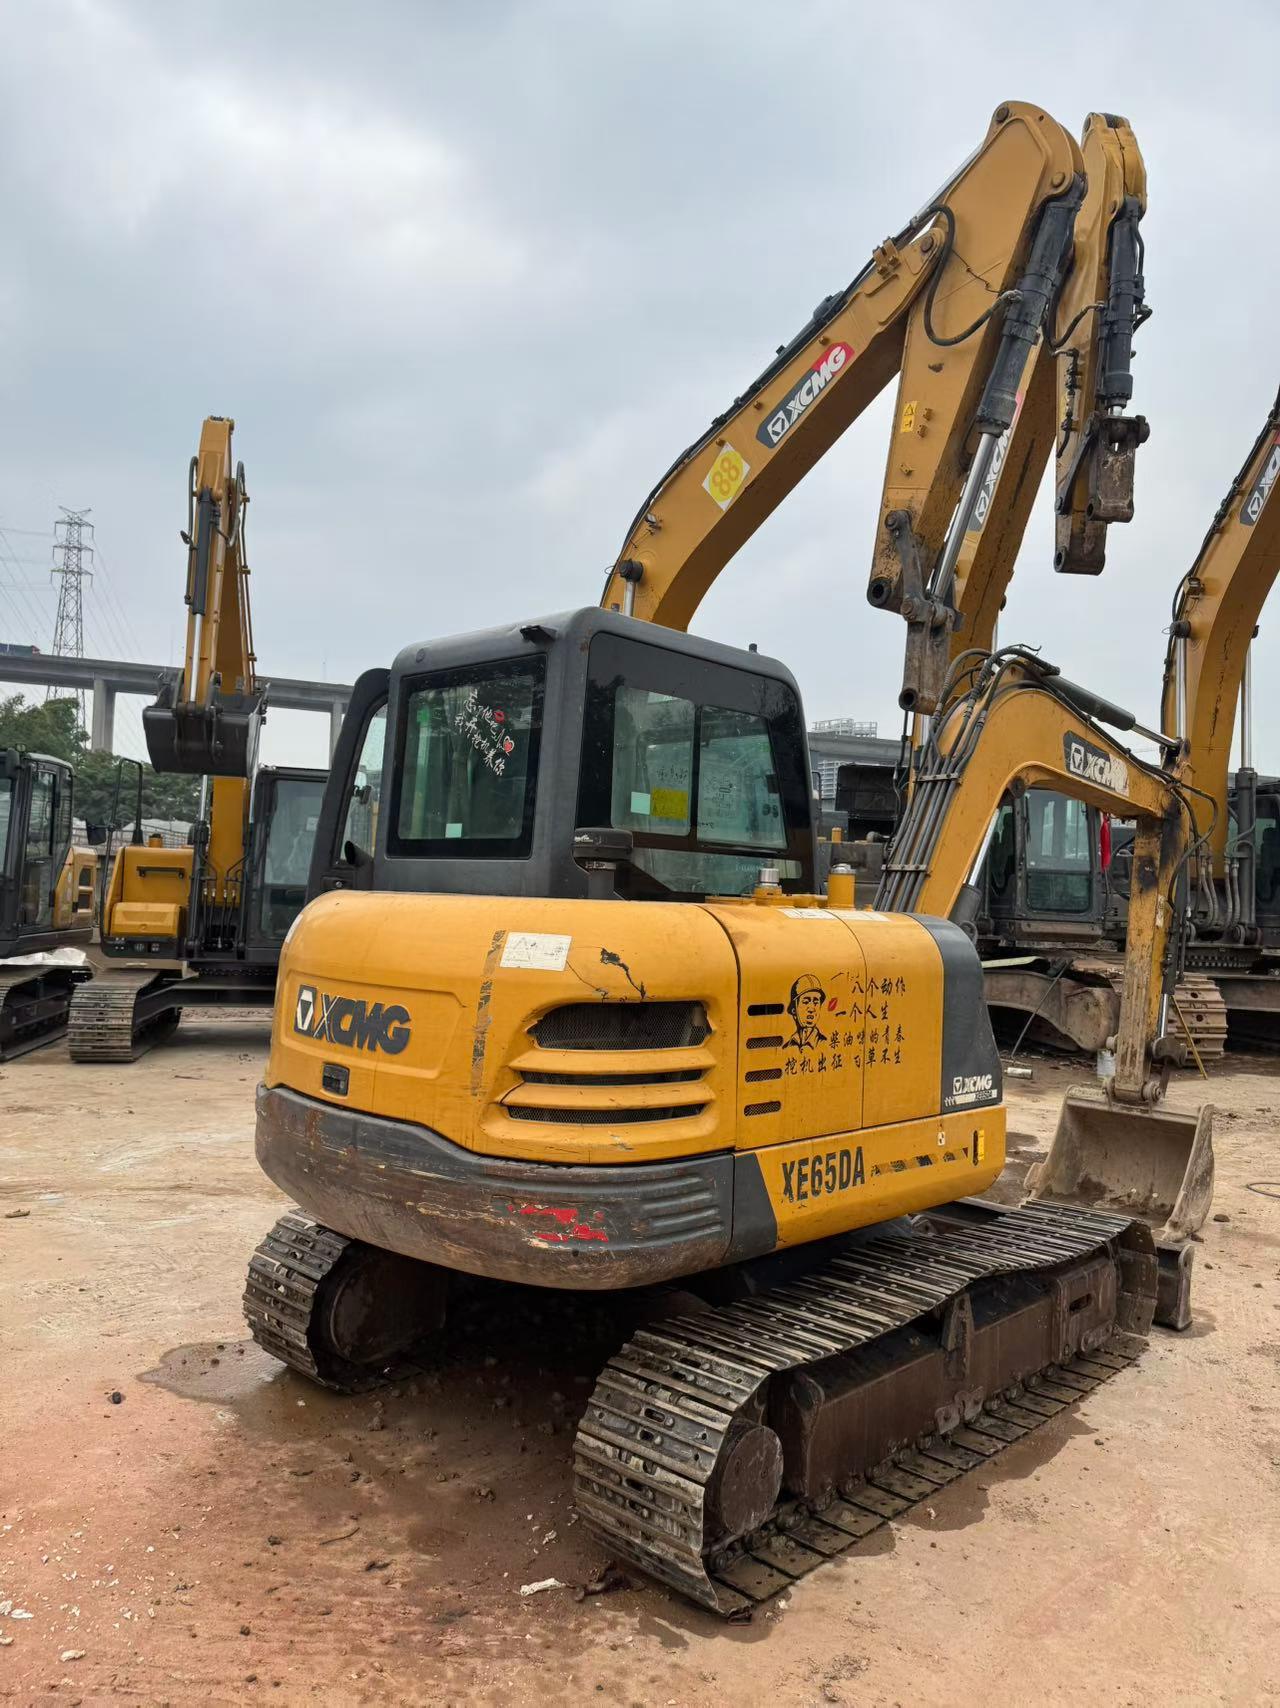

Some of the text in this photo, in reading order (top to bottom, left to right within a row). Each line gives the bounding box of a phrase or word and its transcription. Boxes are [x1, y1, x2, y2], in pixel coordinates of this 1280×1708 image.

[786, 345, 847, 425] XCMG
[985, 426, 1013, 500] XCM
[851, 976, 906, 998] 八个动作
[312, 992, 412, 1056] XCMG
[835, 1001, 889, 1023] 一个人生
[829, 1023, 905, 1049] 柴油味的青春
[784, 1052, 843, 1076] 挖机出征
[962, 1073, 993, 1094] XCMG
[781, 1145, 866, 1204] XE65DA
